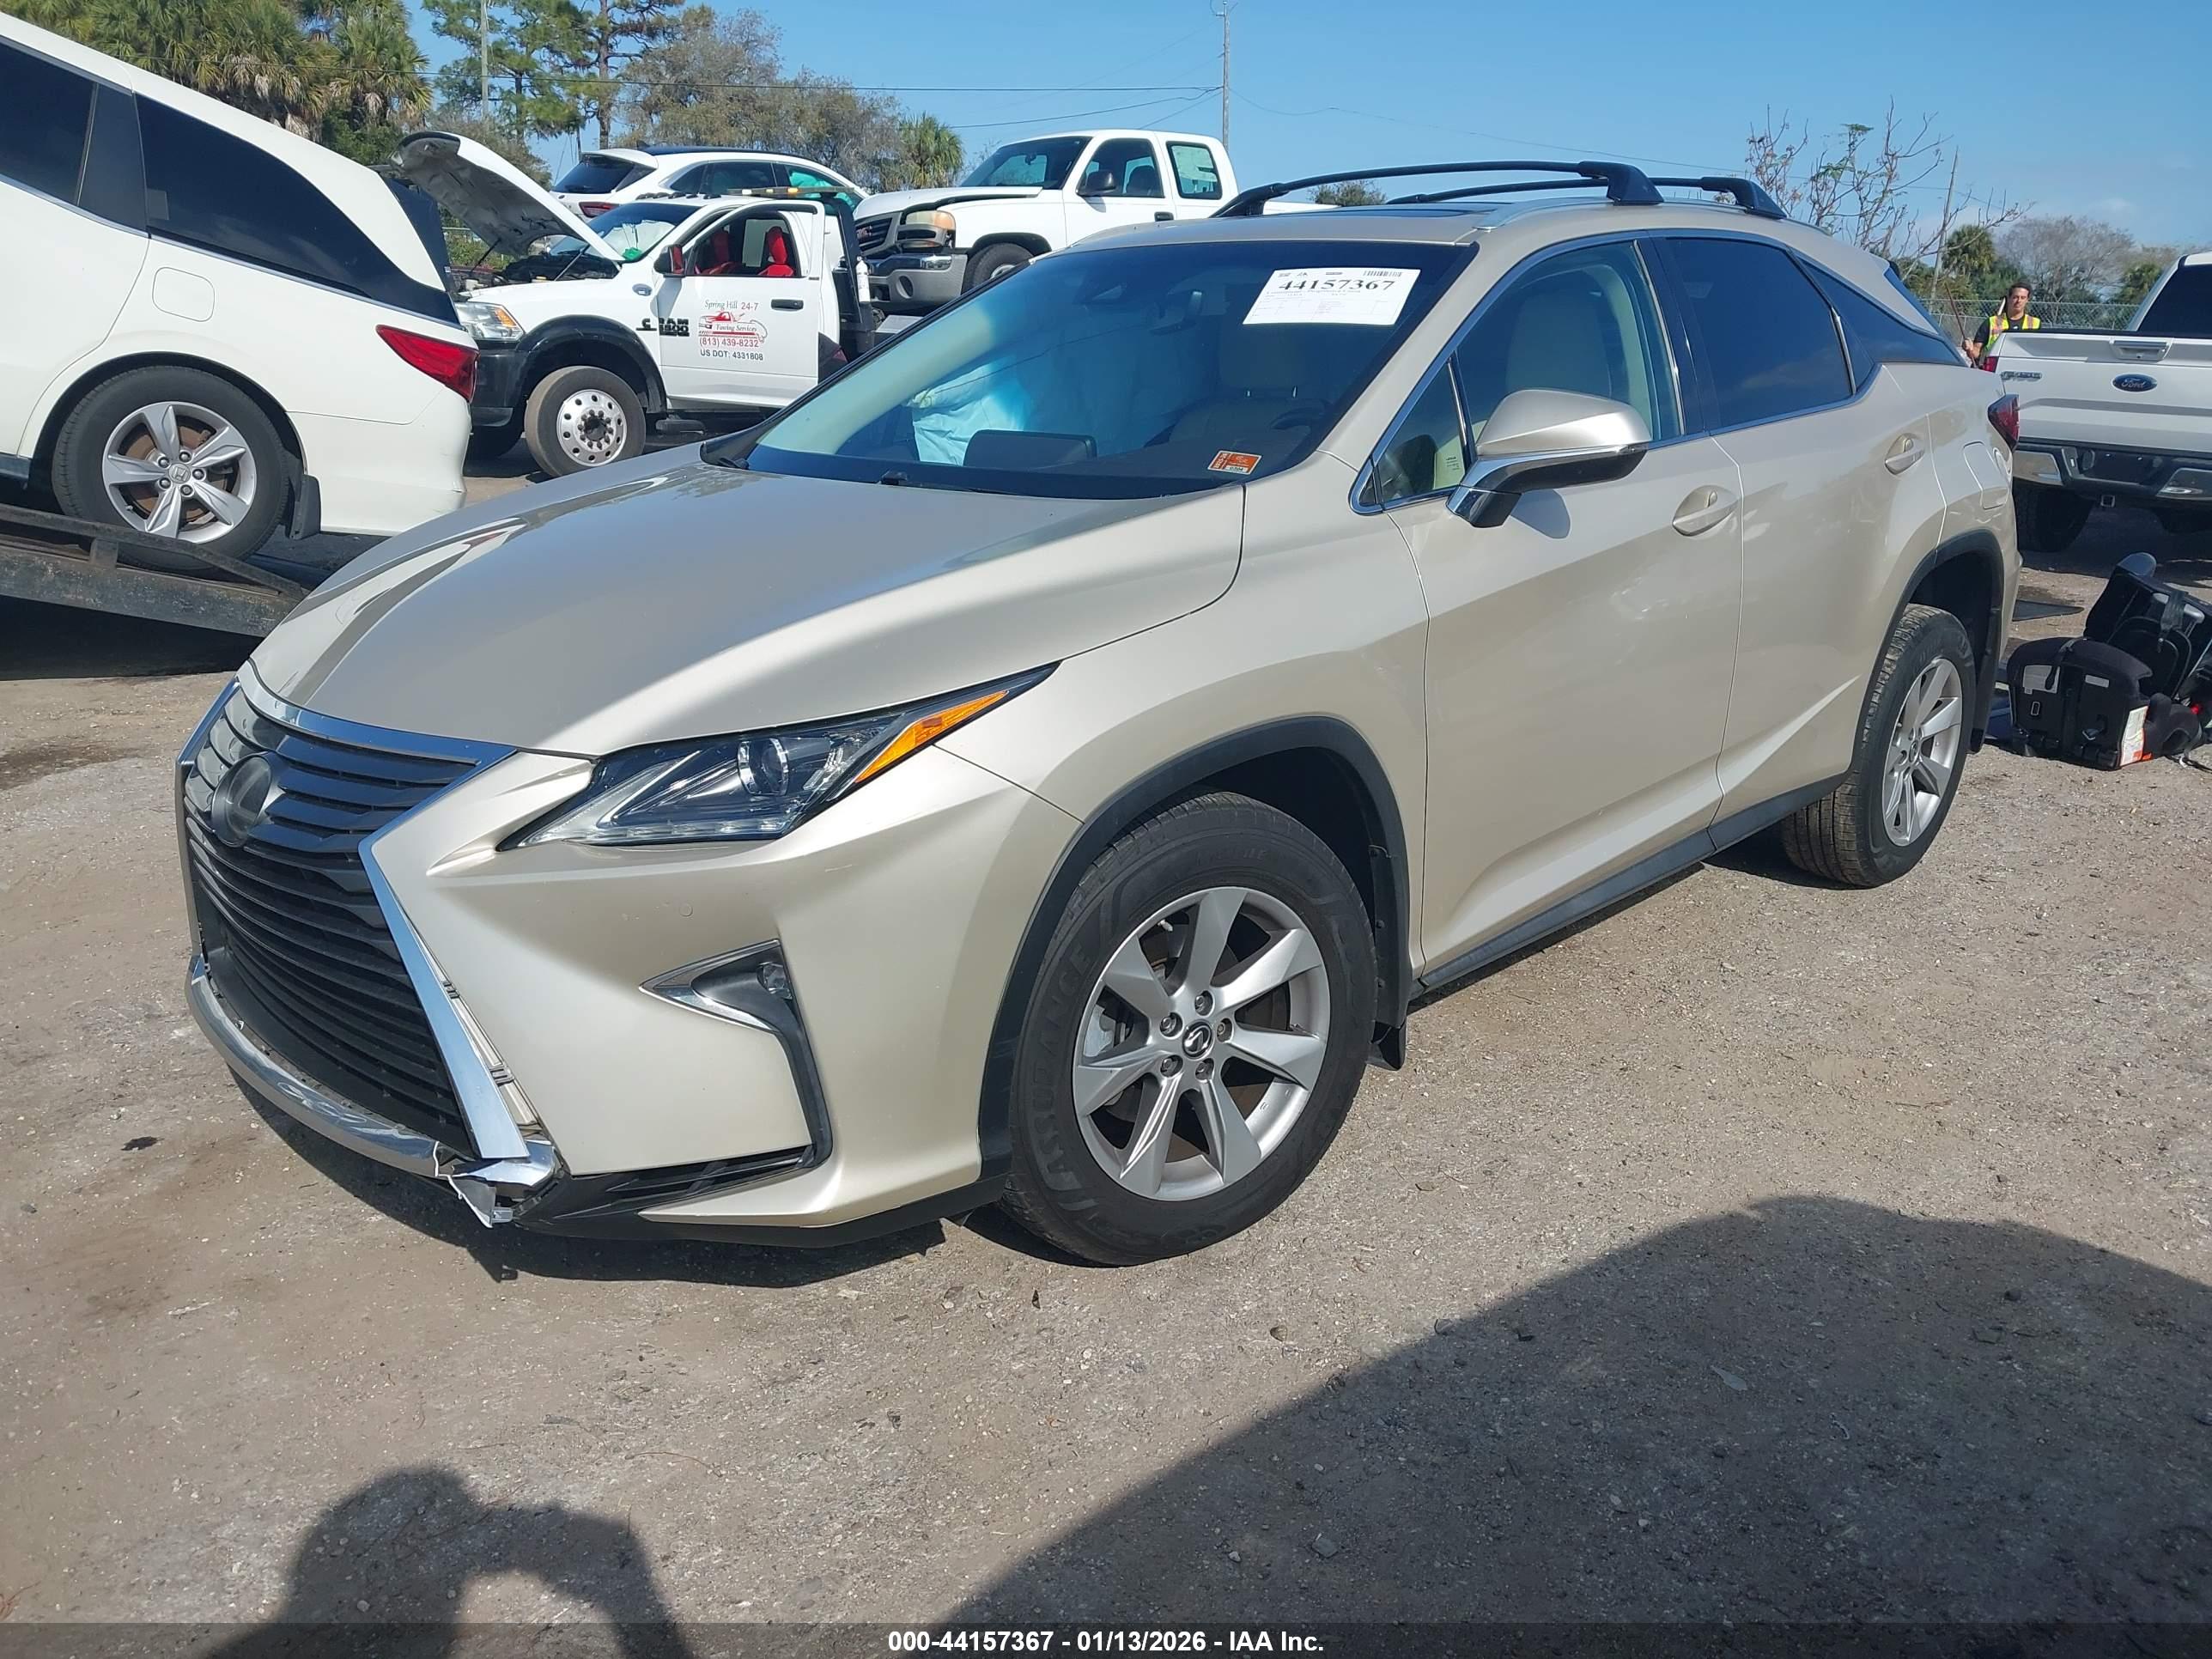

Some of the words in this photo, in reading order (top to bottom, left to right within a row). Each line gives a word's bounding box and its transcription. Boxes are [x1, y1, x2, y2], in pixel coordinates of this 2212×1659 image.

[1279, 279, 1395, 290] 44157367
[704, 299, 725, 310] Spring
[726, 301, 738, 309] Hill
[741, 301, 758, 310] 24-7
[716, 324, 734, 332] Towing
[700, 337, 720, 347] (813)
[721, 338, 759, 348] 439-8232
[701, 349, 711, 357] US
[713, 349, 730, 358] DOT:
[732, 351, 763, 361] 4331808
